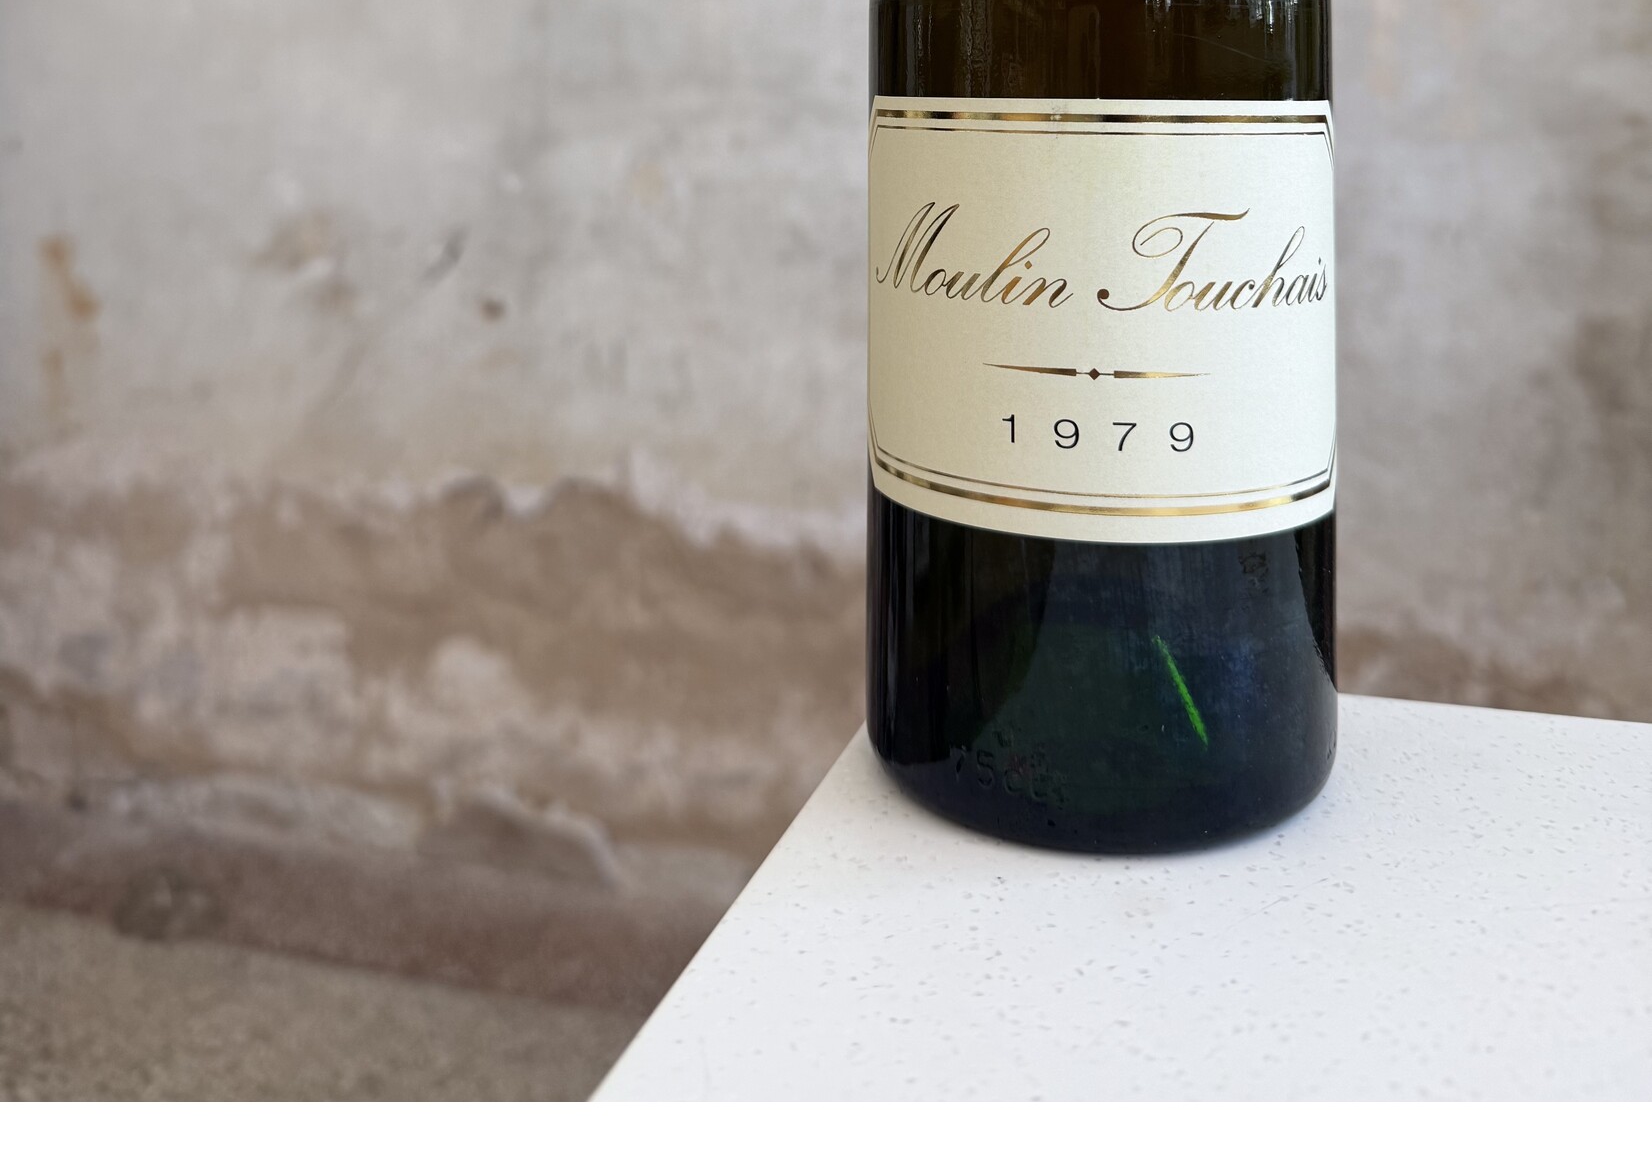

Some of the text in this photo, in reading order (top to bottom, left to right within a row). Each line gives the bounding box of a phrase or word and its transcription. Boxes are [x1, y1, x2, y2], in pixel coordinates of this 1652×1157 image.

[875, 200, 1328, 312] Moulin Touchais
[1001, 413, 1195, 453] 1979
